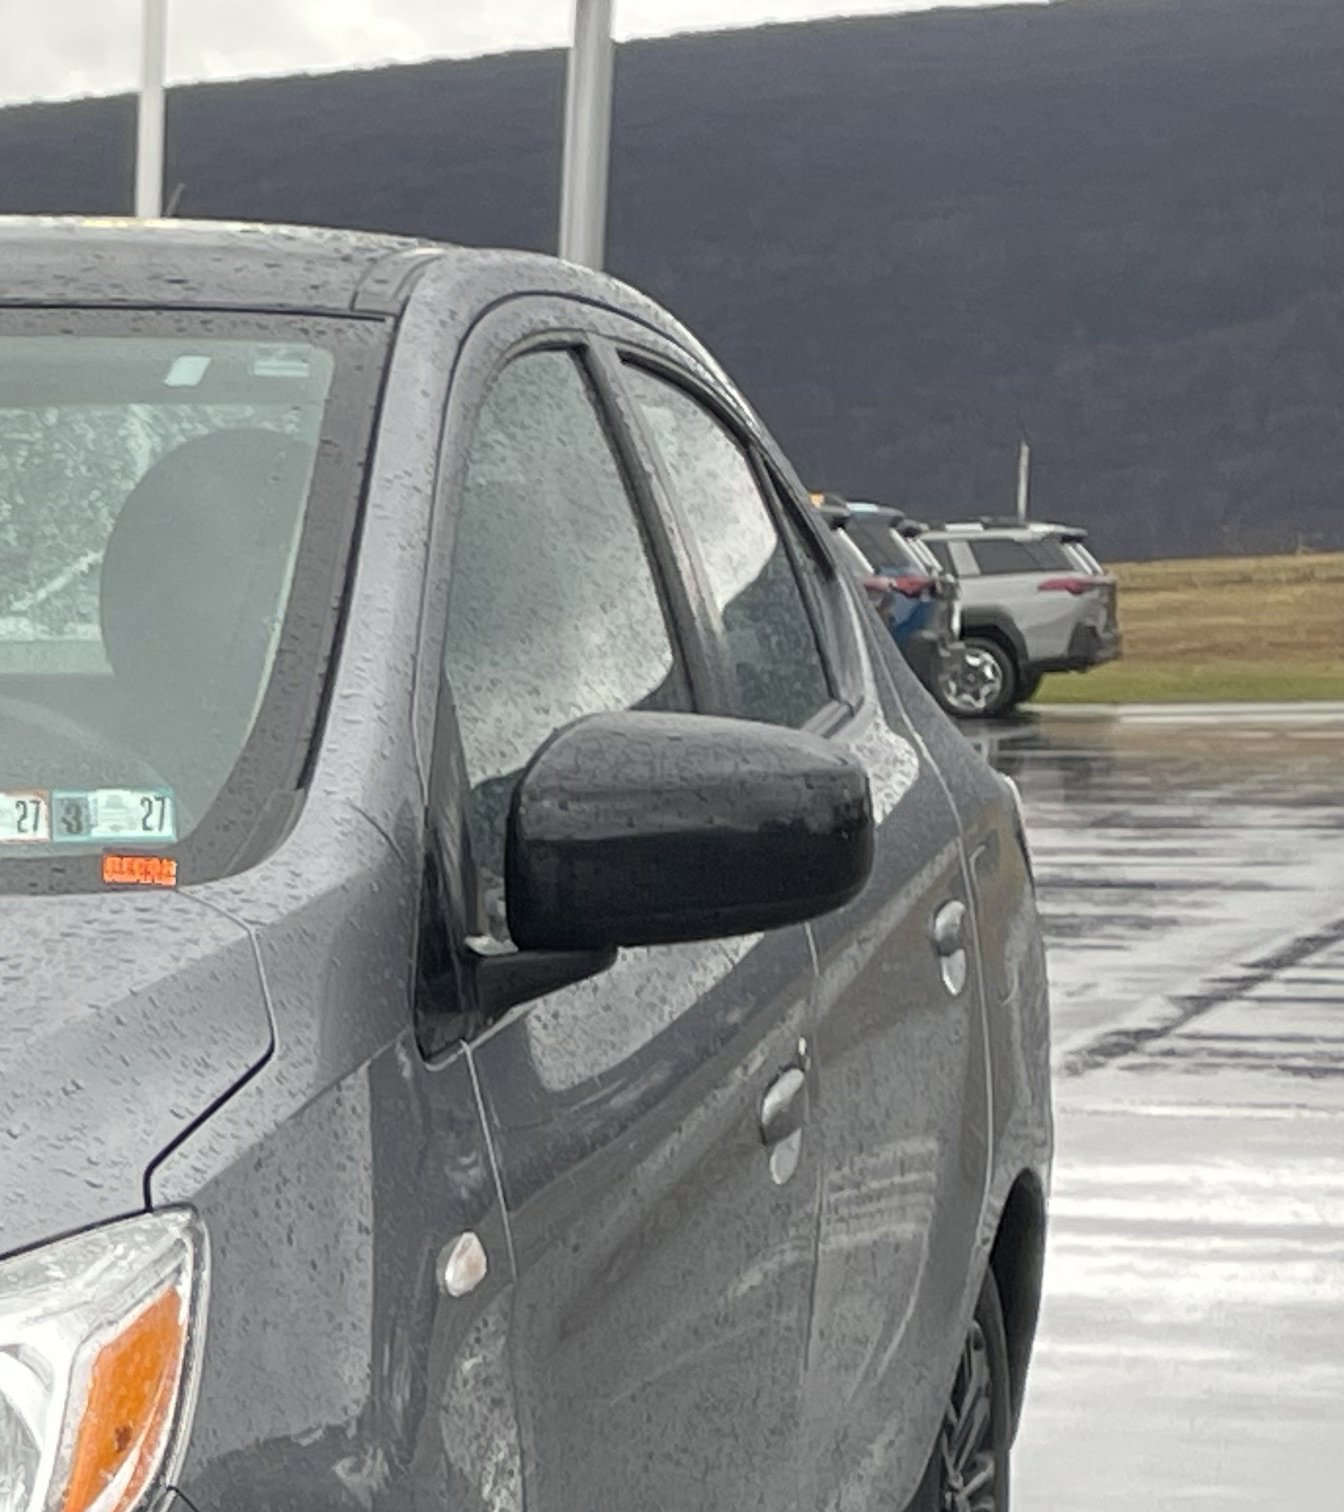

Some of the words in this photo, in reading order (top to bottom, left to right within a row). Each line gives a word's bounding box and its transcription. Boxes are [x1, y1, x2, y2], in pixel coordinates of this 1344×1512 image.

[15, 800, 43, 833] 27
[62, 803, 83, 834] 3
[140, 796, 167, 832] 27
